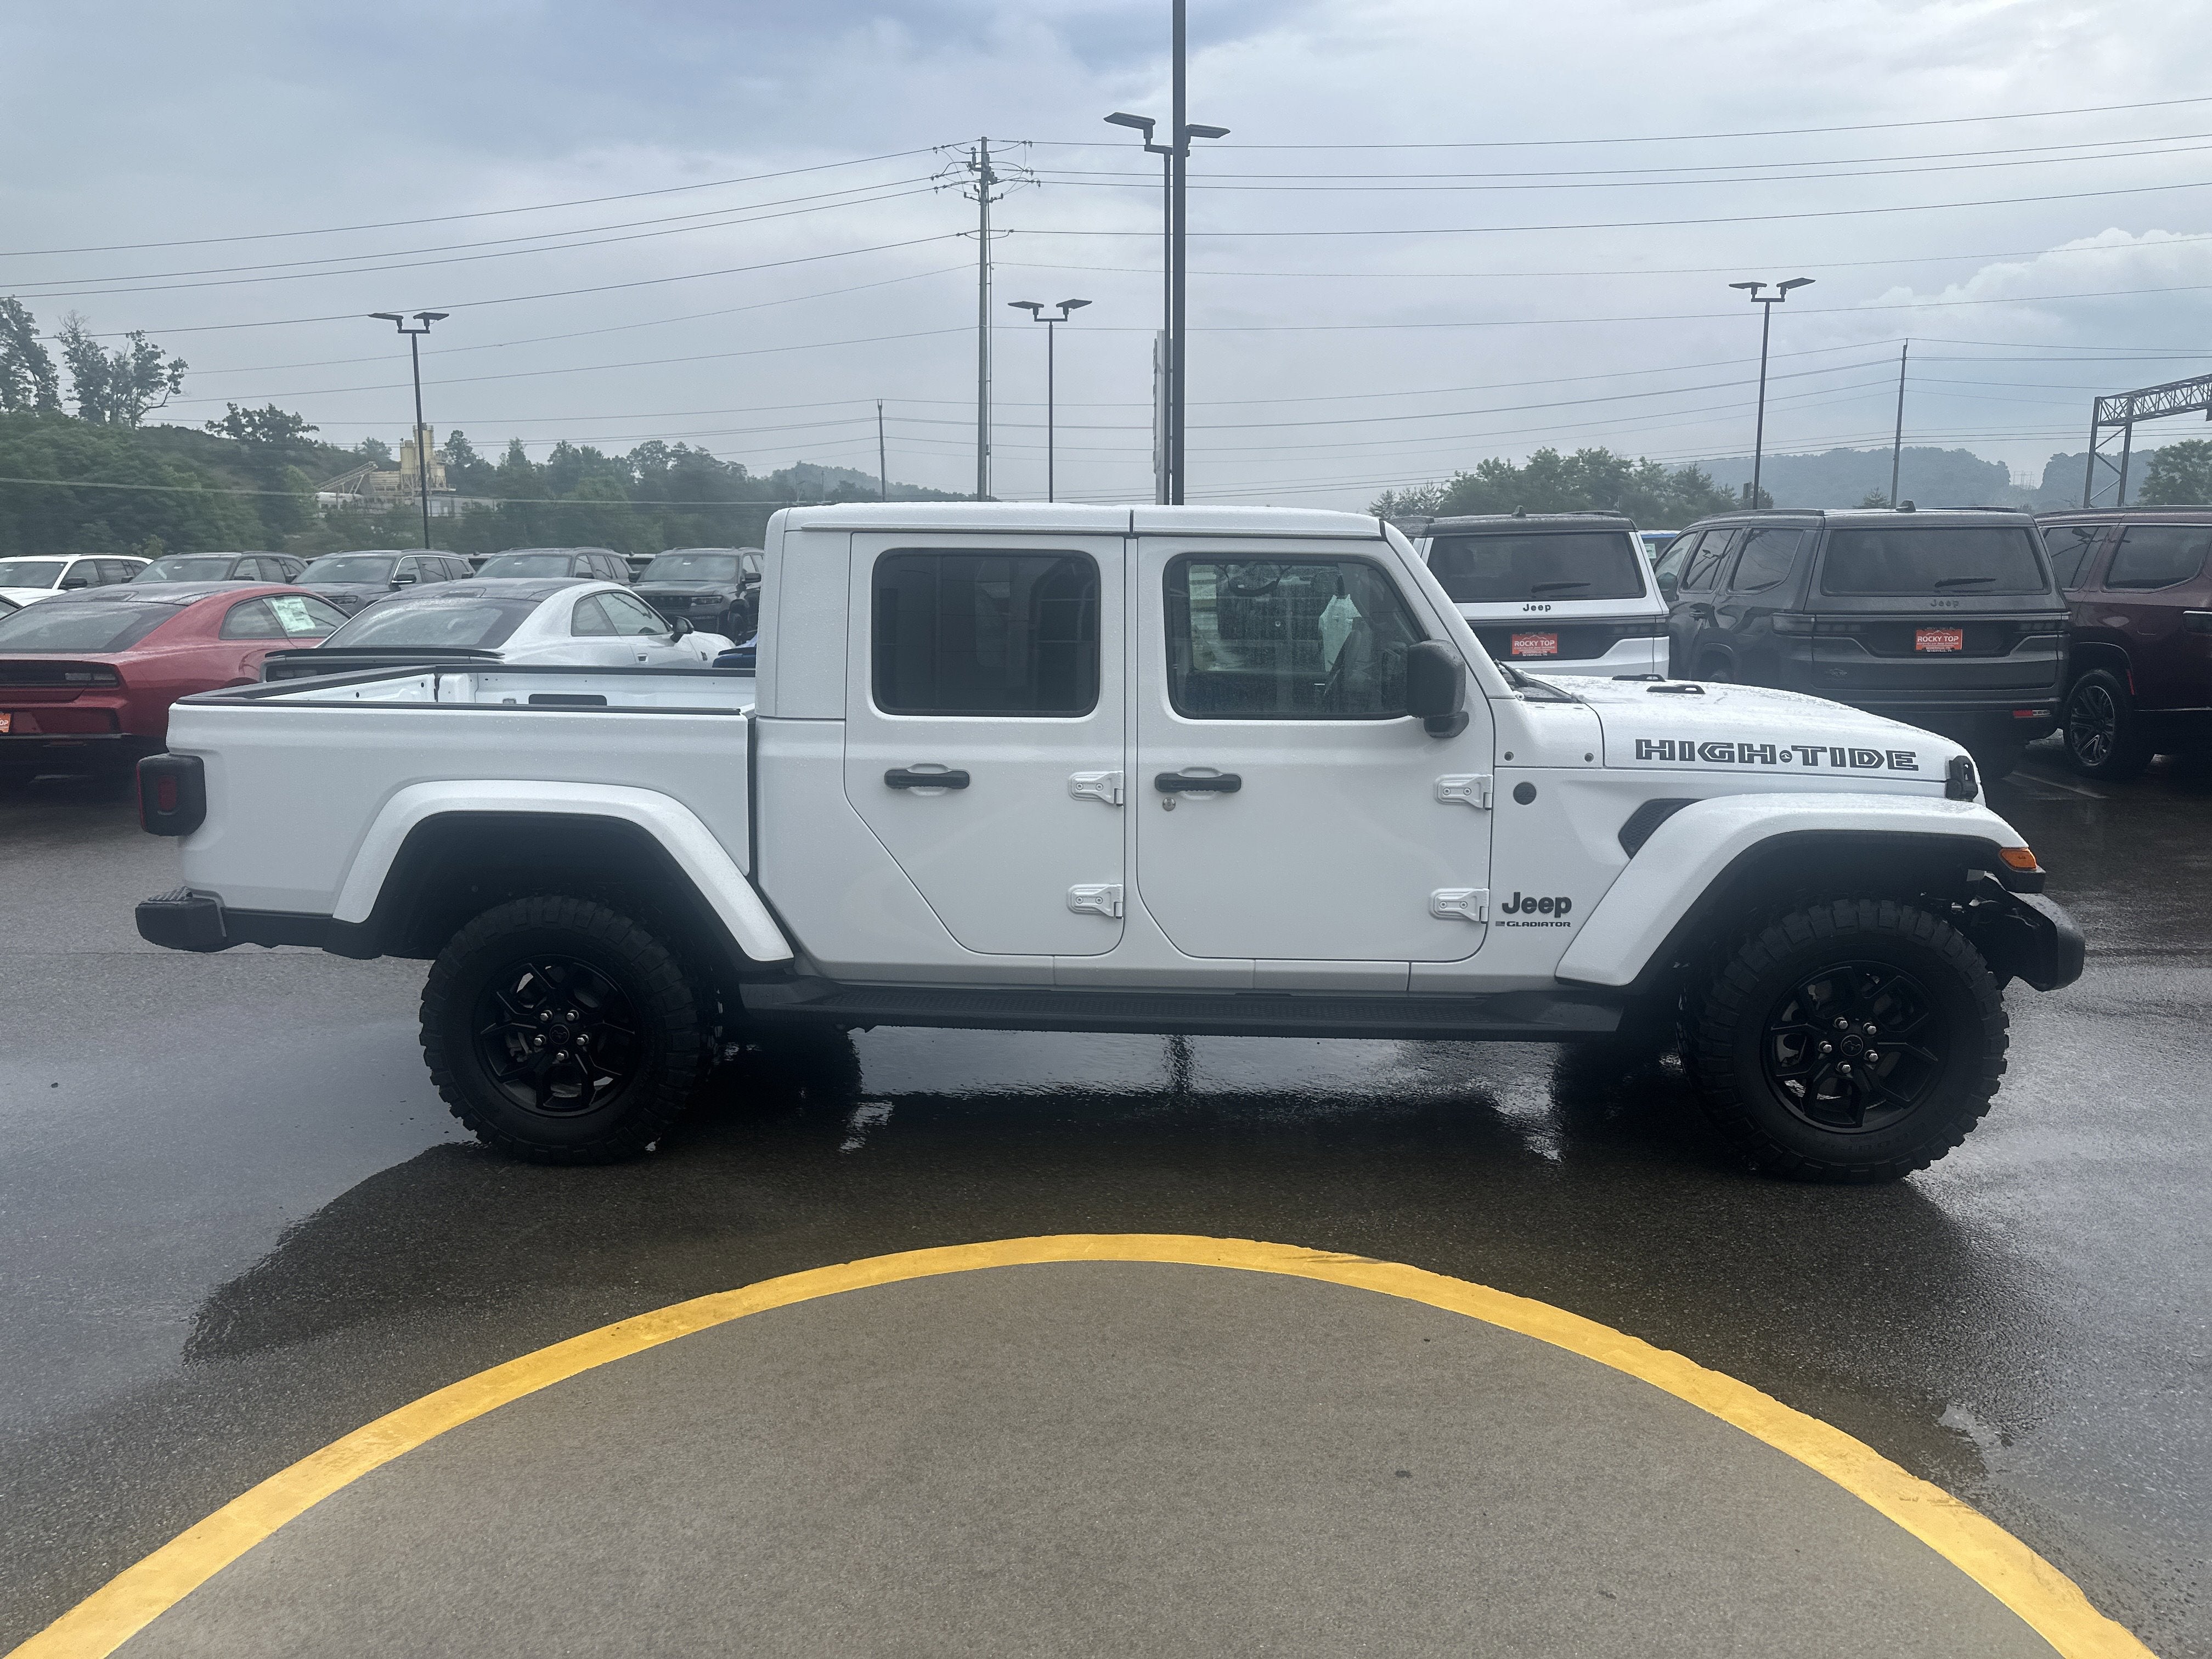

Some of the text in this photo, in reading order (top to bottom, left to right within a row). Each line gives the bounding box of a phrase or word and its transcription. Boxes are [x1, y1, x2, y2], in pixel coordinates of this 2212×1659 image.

[1523, 603, 1551, 612] Jeep
[1931, 599, 1959, 608] Jeep
[1635, 739, 1919, 771] HIGH TIDE
[1502, 891, 1572, 918] Jeep
